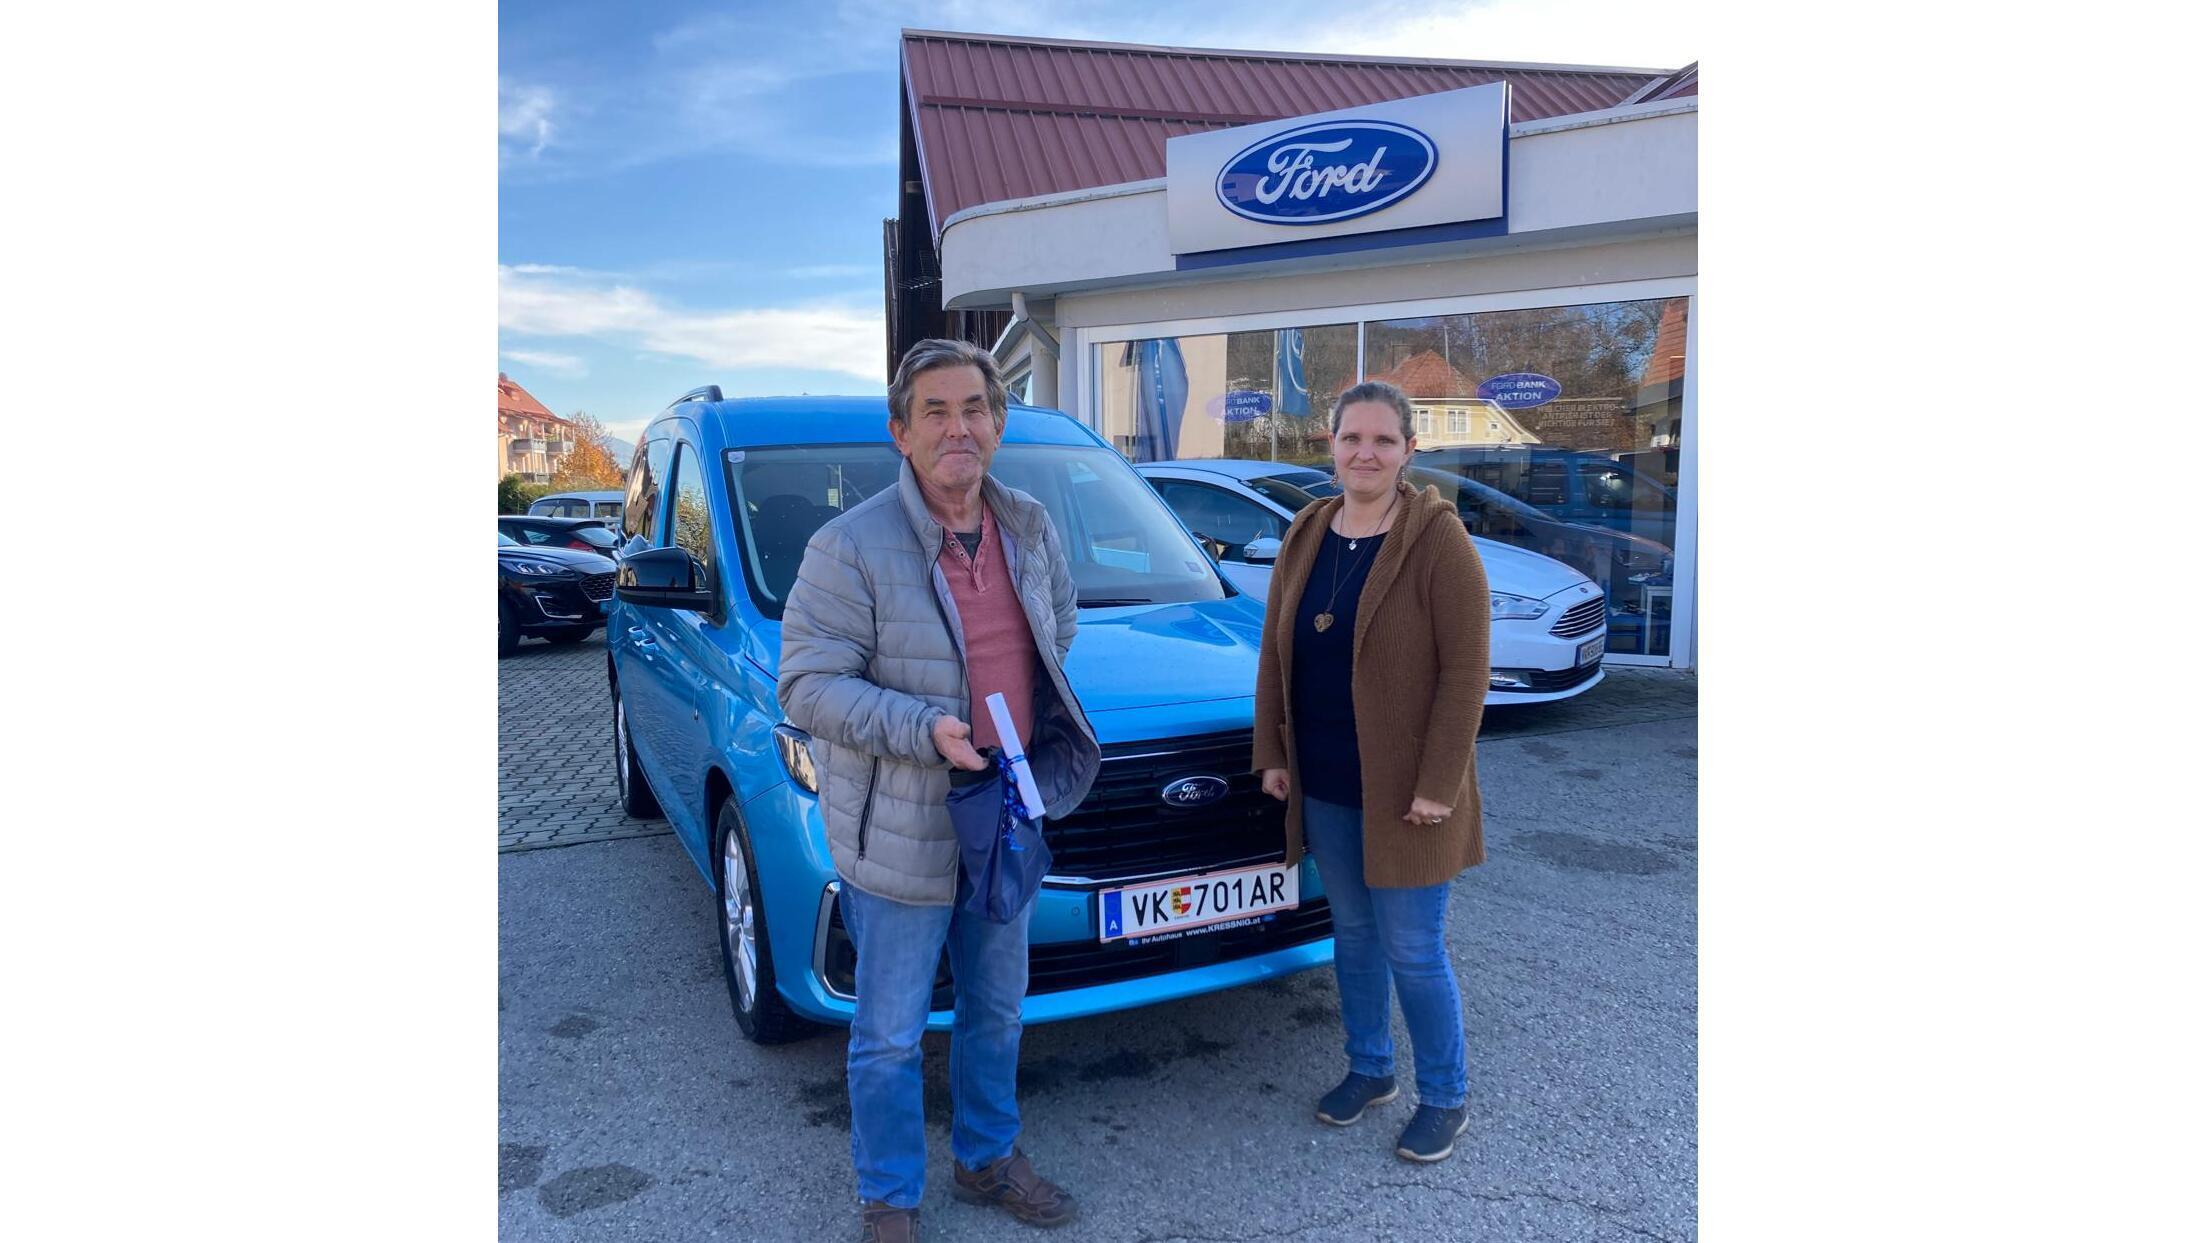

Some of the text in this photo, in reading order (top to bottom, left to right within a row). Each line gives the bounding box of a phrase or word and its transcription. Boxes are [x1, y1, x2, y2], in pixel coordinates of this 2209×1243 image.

[1255, 138, 1387, 205] Ford
[1517, 380, 1546, 388] BANK
[1495, 391, 1542, 401] AKTION
[1179, 782, 1216, 801] Ford
[1132, 890, 1169, 927] VK
[1109, 919, 1118, 931] A
[1151, 932, 1183, 943] Autohaus
[1186, 917, 1261, 937] www.KRESSNIG.at
